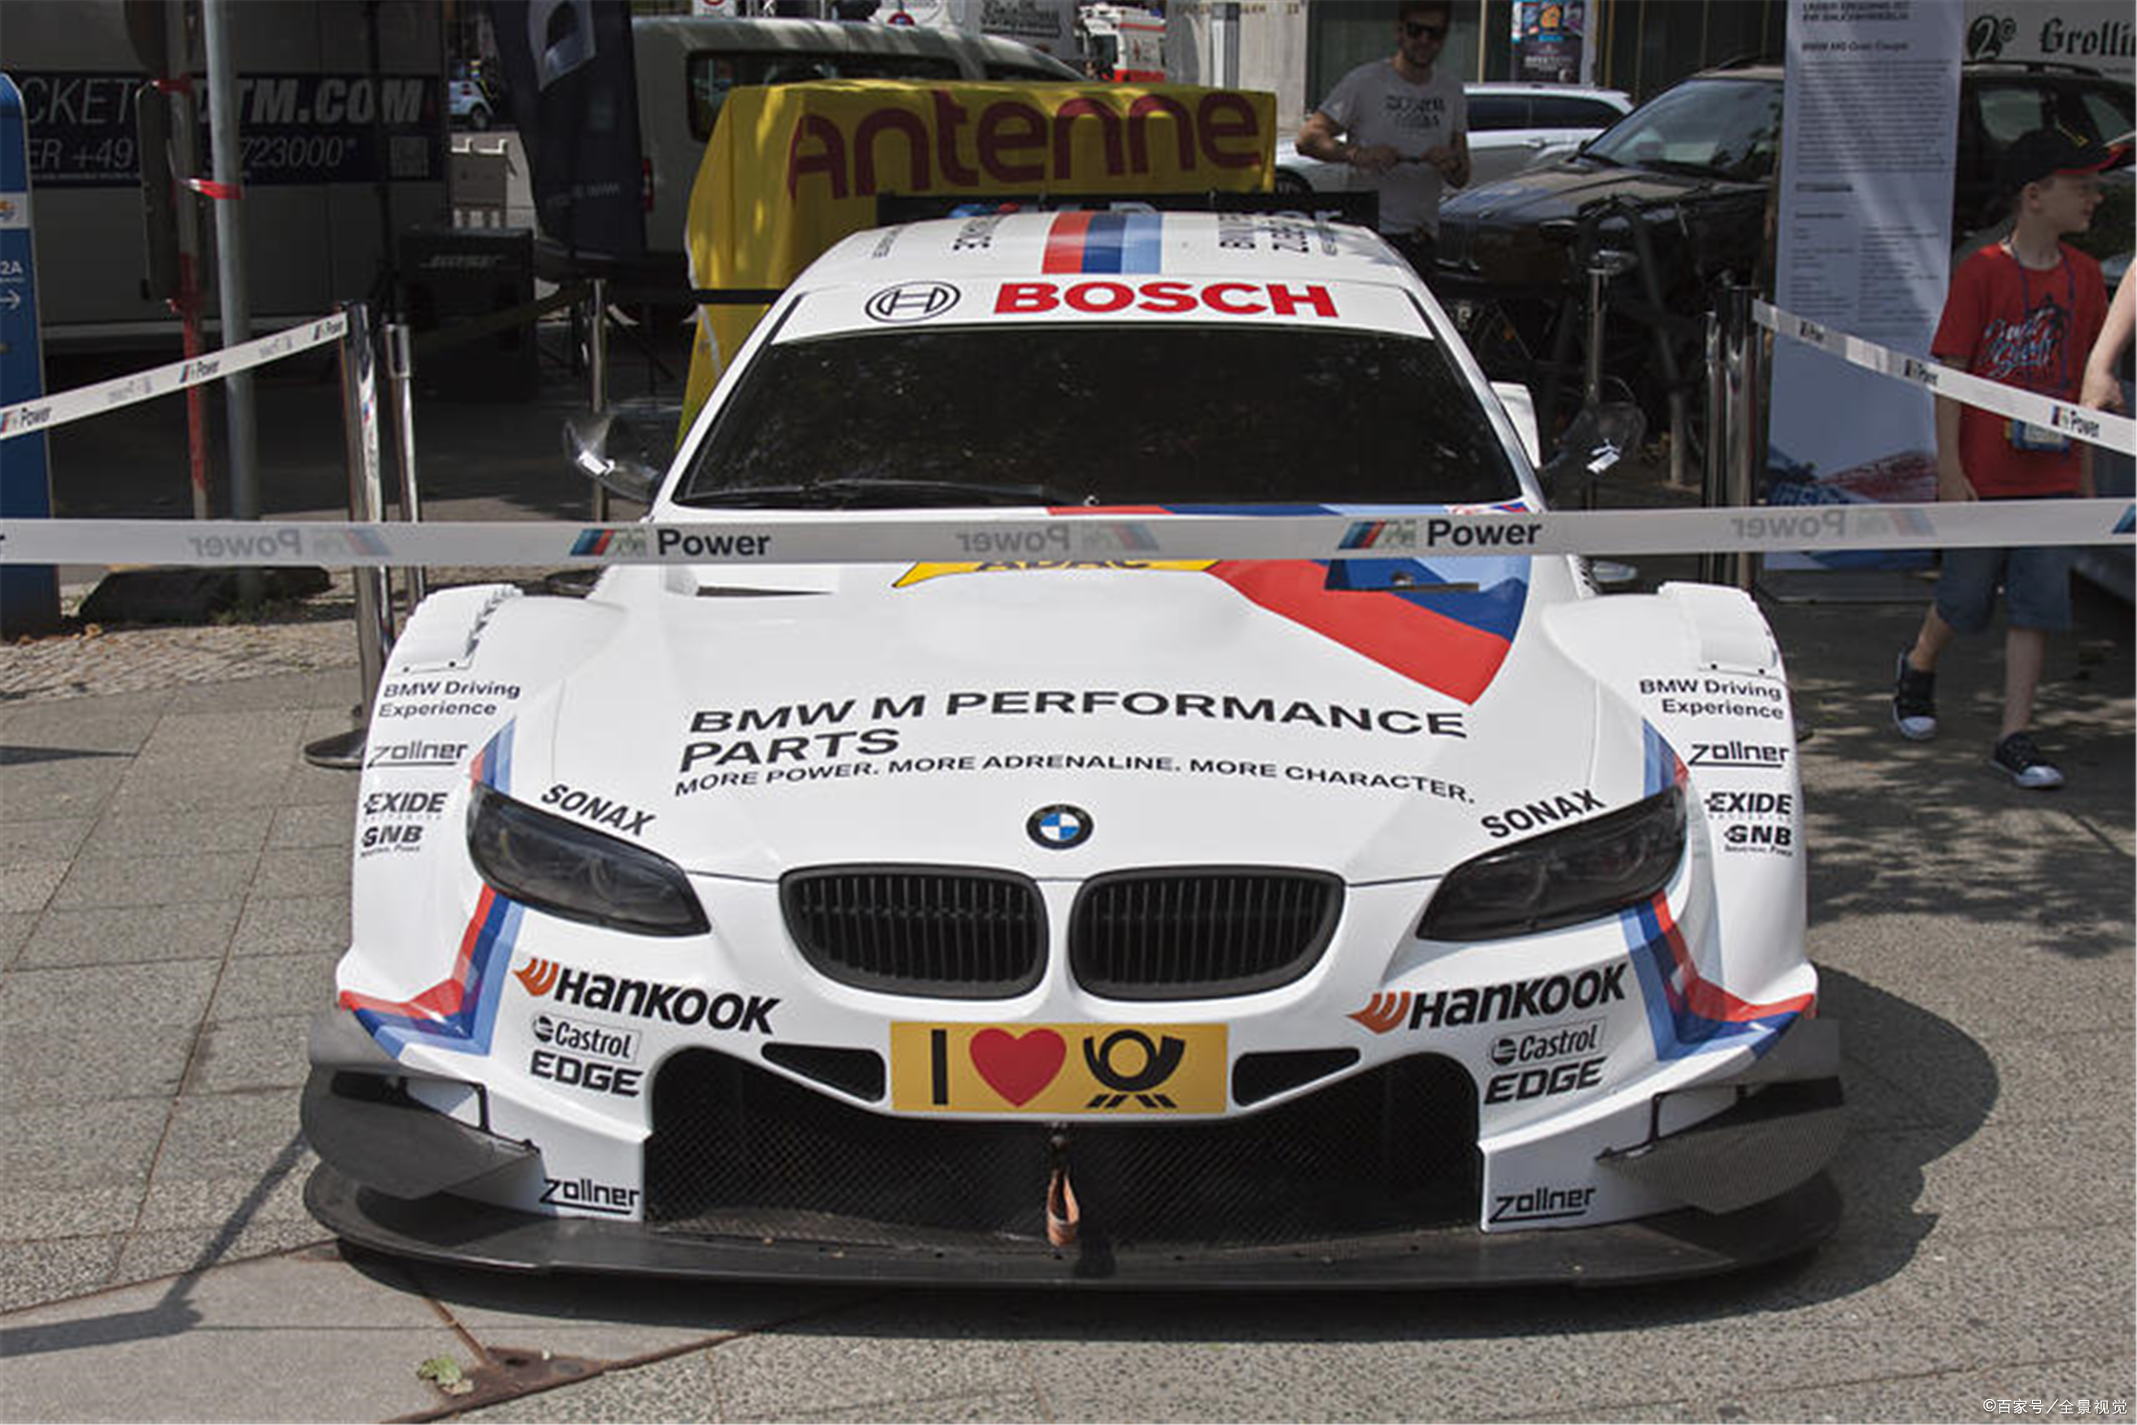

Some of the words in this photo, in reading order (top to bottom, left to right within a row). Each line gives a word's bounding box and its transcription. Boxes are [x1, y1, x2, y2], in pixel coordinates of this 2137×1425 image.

[993, 281, 1340, 318] BOSCH
[657, 528, 771, 556] Power
[1427, 518, 1542, 547] Power
[384, 681, 440, 698] BMW
[445, 680, 521, 699] Driving
[1640, 678, 1698, 695] BMW
[1703, 679, 1782, 701] Driving
[378, 702, 497, 719] Experience
[689, 699, 857, 733] BMW
[871, 694, 926, 720] M
[945, 690, 1468, 739] PERFORMANCE
[1661, 697, 1785, 720] Experience
[678, 728, 900, 774] PARTS
[674, 770, 758, 798] MORE
[765, 762, 879, 784] POWER.
[887, 755, 976, 774] MORE
[981, 754, 1182, 772] ADRENALINE.
[1189, 758, 1277, 778] MORE
[1284, 765, 1476, 804] CHARACTER.
[363, 791, 448, 815] EXIDE
[540, 782, 656, 837] SONAX
[1480, 788, 1607, 839] SONAX
[1703, 791, 1793, 816] EXIDE
[1723, 824, 1792, 847] GNB
[554, 1020, 632, 1060] Castrol
[1518, 1024, 1597, 1063] Castrol
[530, 1049, 644, 1098] EDGE
[1484, 1056, 1609, 1105] EDGE
